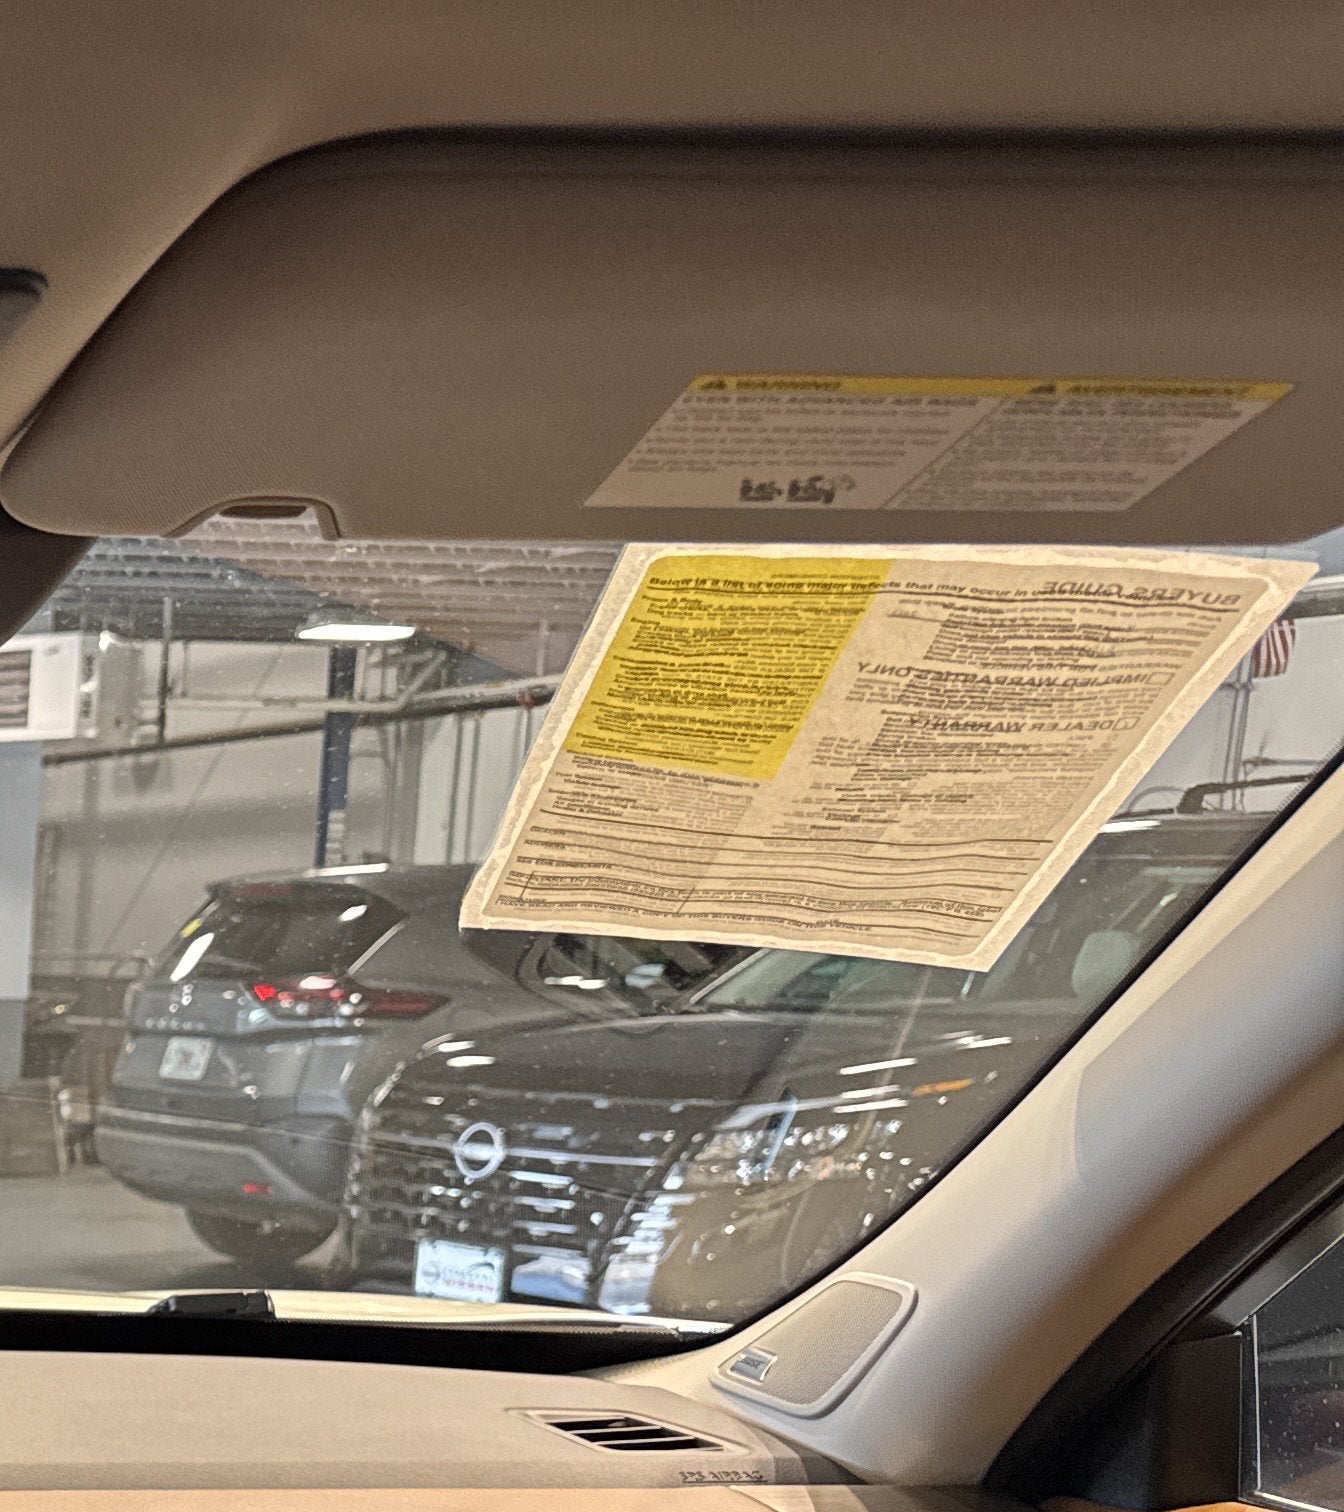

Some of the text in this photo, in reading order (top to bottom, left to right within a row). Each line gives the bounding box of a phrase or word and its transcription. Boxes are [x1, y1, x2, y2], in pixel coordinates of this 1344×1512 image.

[650, 577, 691, 586] Below
[905, 581, 935, 590] that
[937, 583, 967, 594] may
[970, 587, 1012, 597] occur
[1015, 588, 1028, 597] in
